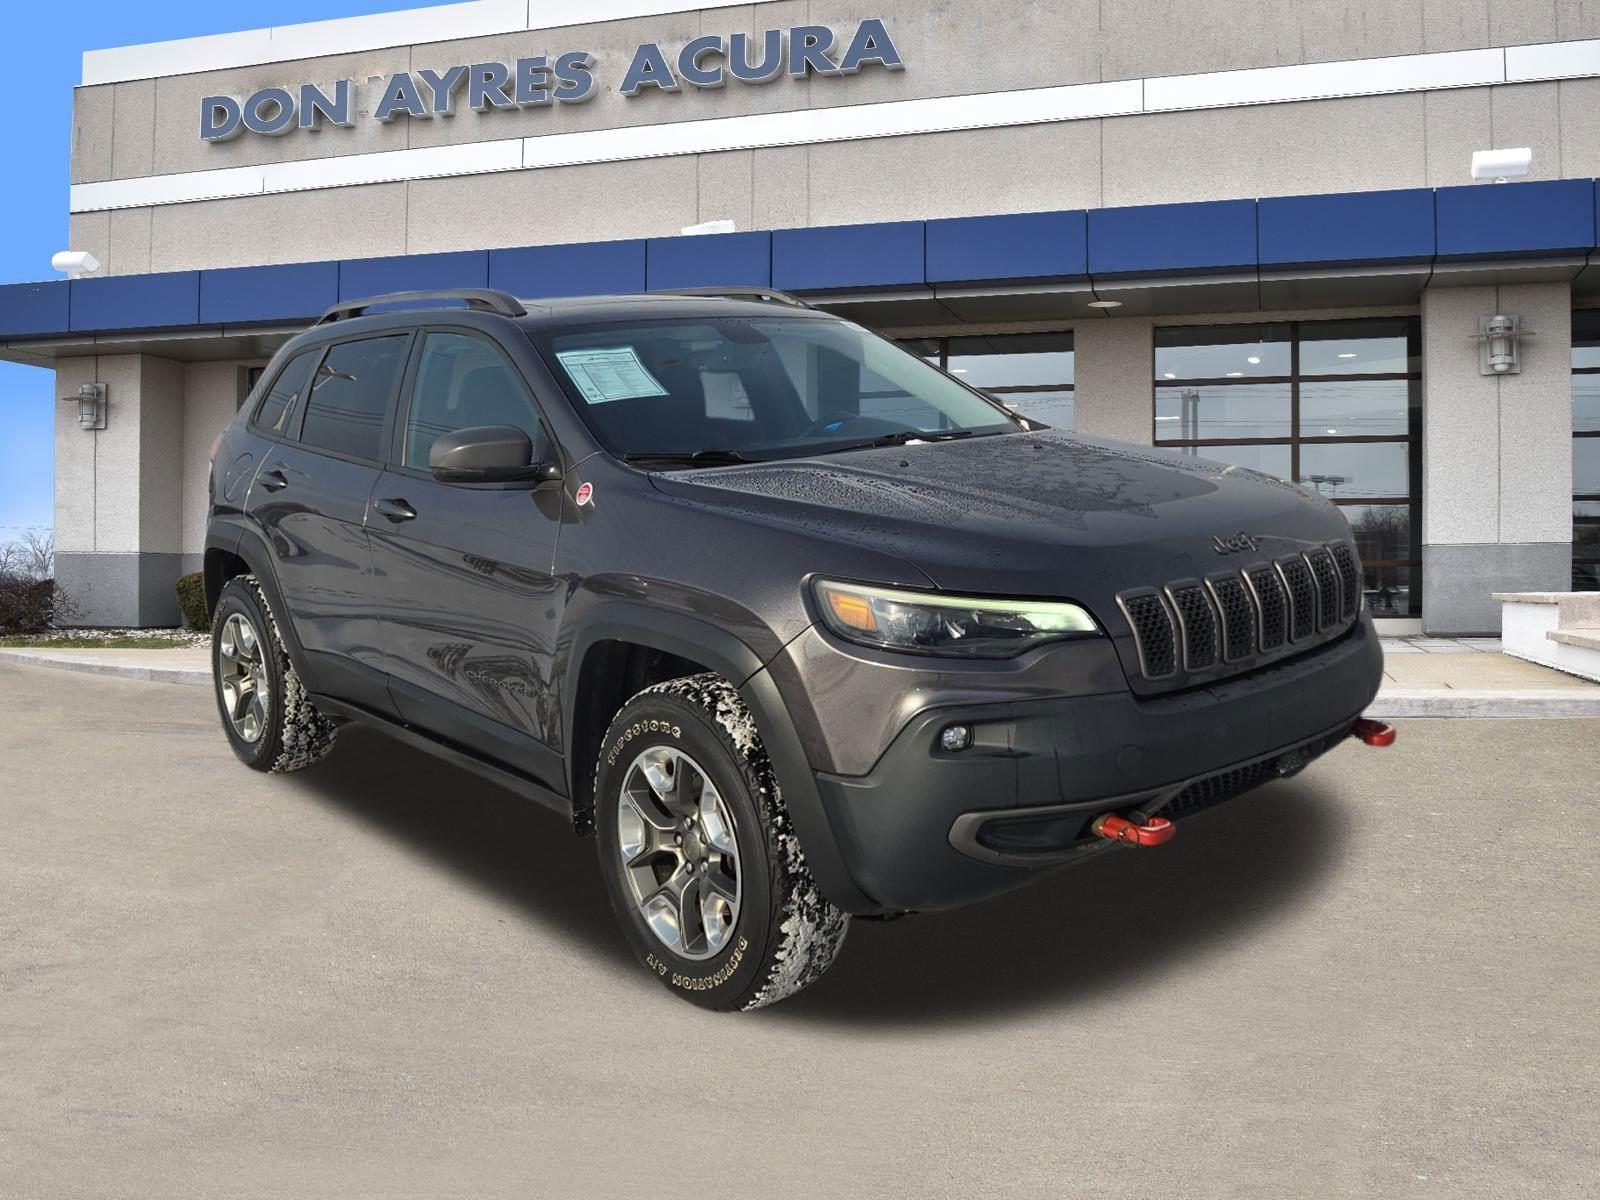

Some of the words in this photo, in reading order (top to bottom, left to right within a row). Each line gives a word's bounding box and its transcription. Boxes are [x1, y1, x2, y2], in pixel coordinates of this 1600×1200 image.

[200, 80, 355, 142] DON
[375, 51, 597, 122] AYRES
[620, 17, 904, 97] ACURA
[1214, 534, 1260, 555] Jeep
[672, 936, 748, 990] DESTINATION
